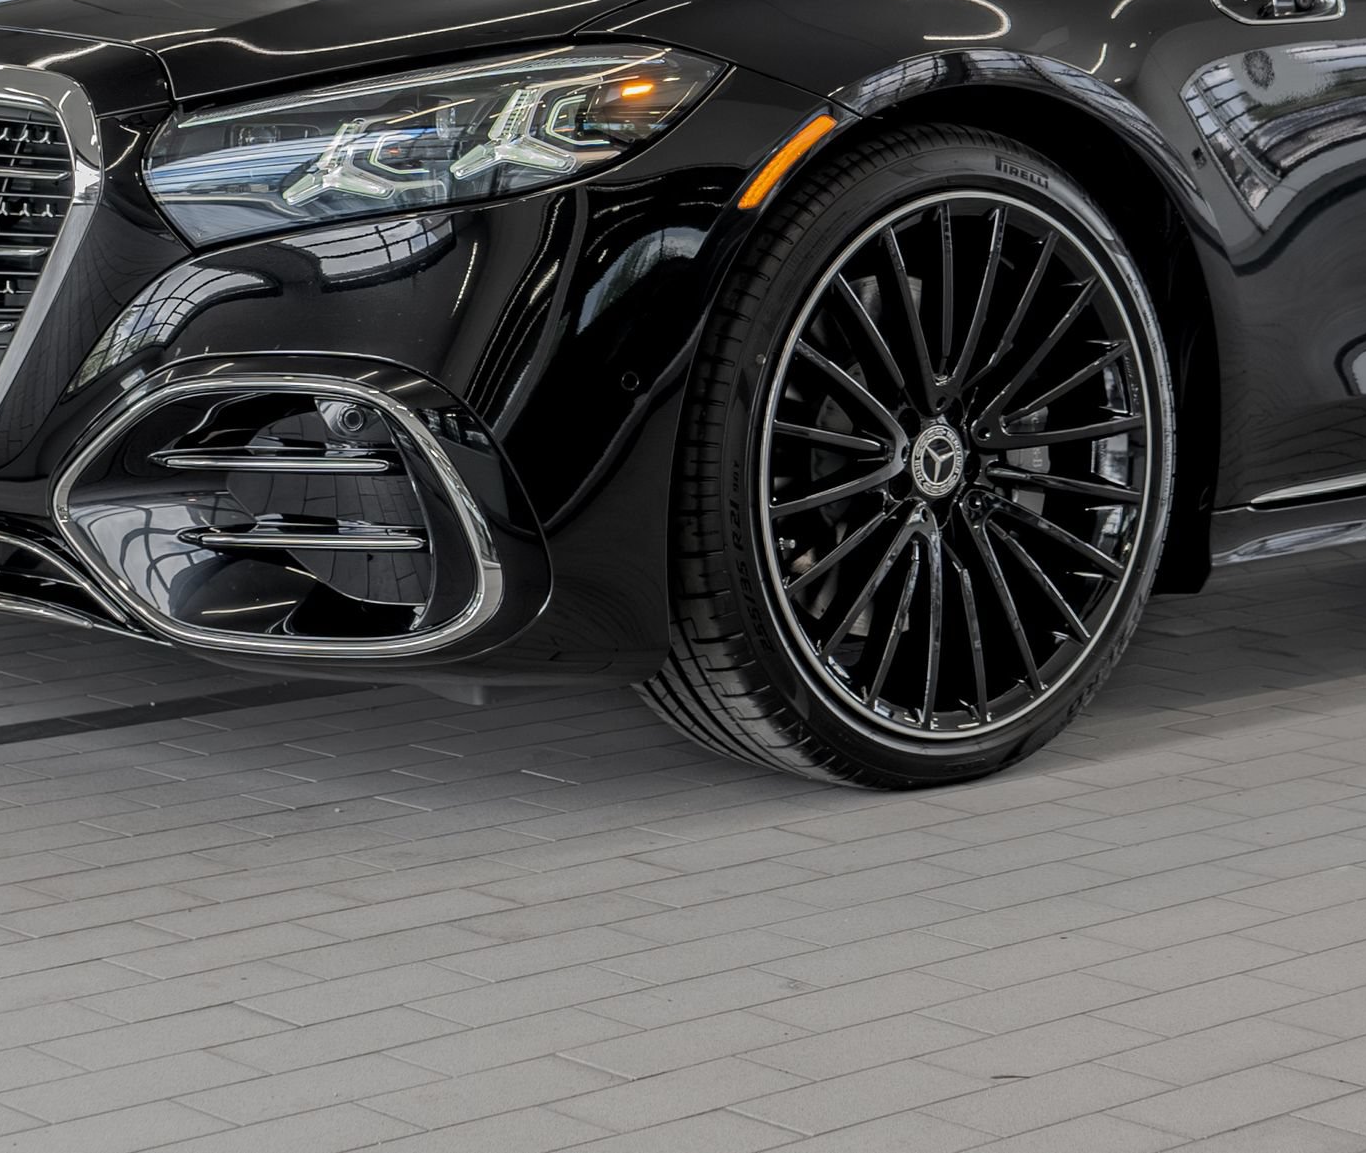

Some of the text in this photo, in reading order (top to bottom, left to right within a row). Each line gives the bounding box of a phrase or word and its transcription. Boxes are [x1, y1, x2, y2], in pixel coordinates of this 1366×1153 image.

[994, 155, 1050, 190] PIRELLI
[728, 498, 744, 551] R21
[735, 558, 776, 654] 255/35
